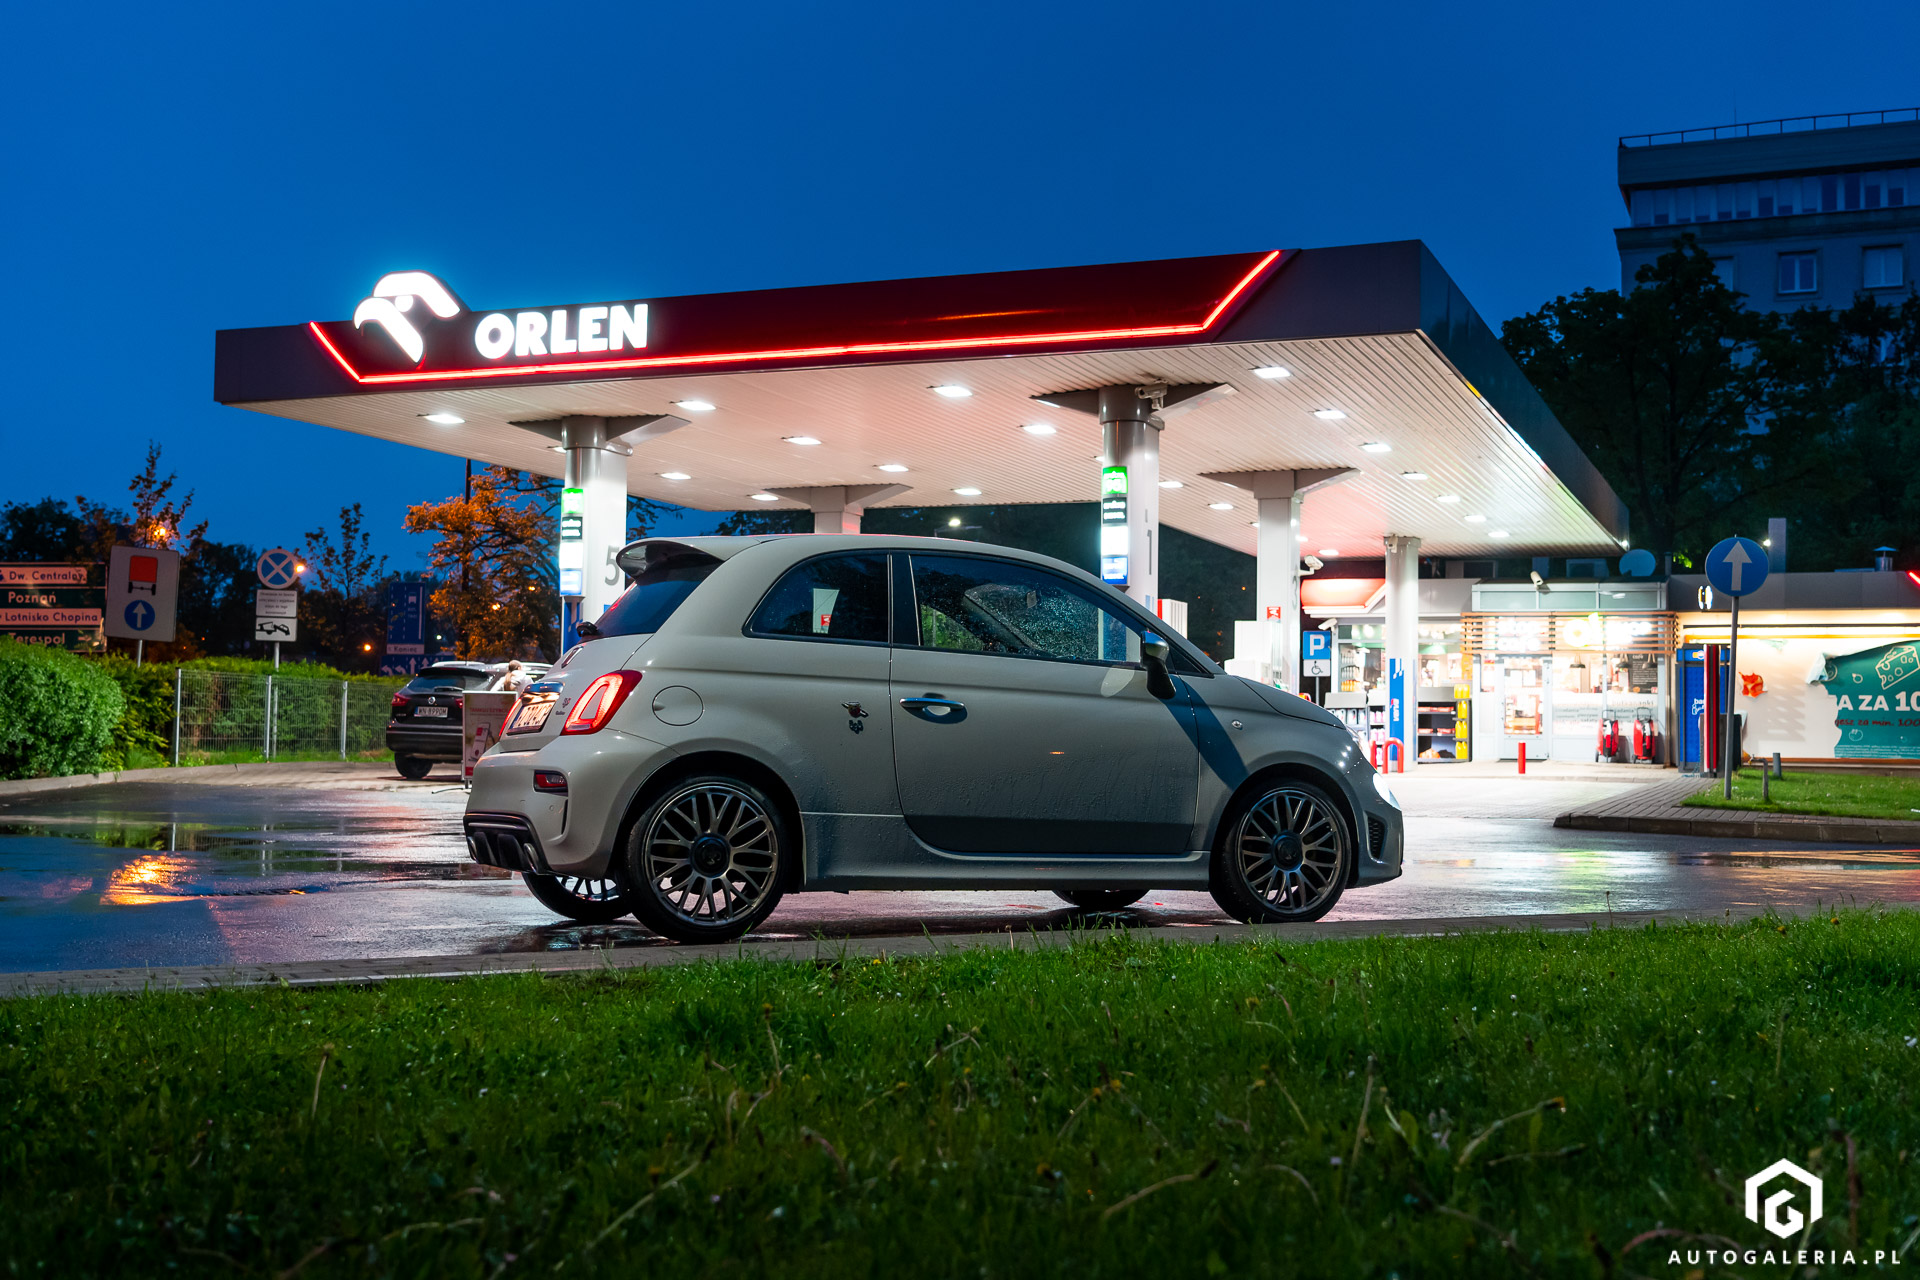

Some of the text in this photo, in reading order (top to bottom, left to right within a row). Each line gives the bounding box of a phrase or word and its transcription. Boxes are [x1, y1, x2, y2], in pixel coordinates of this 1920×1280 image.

[474, 303, 649, 360] ORLEN
[604, 545, 620, 586] 5
[9, 571, 83, 582] Dw. Centralny
[8, 591, 57, 604] Poznań
[5, 612, 98, 623] Lotnisko Chopina
[8, 632, 65, 646] Terespol
[1309, 634, 1325, 656] P
[1835, 694, 1854, 710] A
[1858, 695, 1889, 711] ZA
